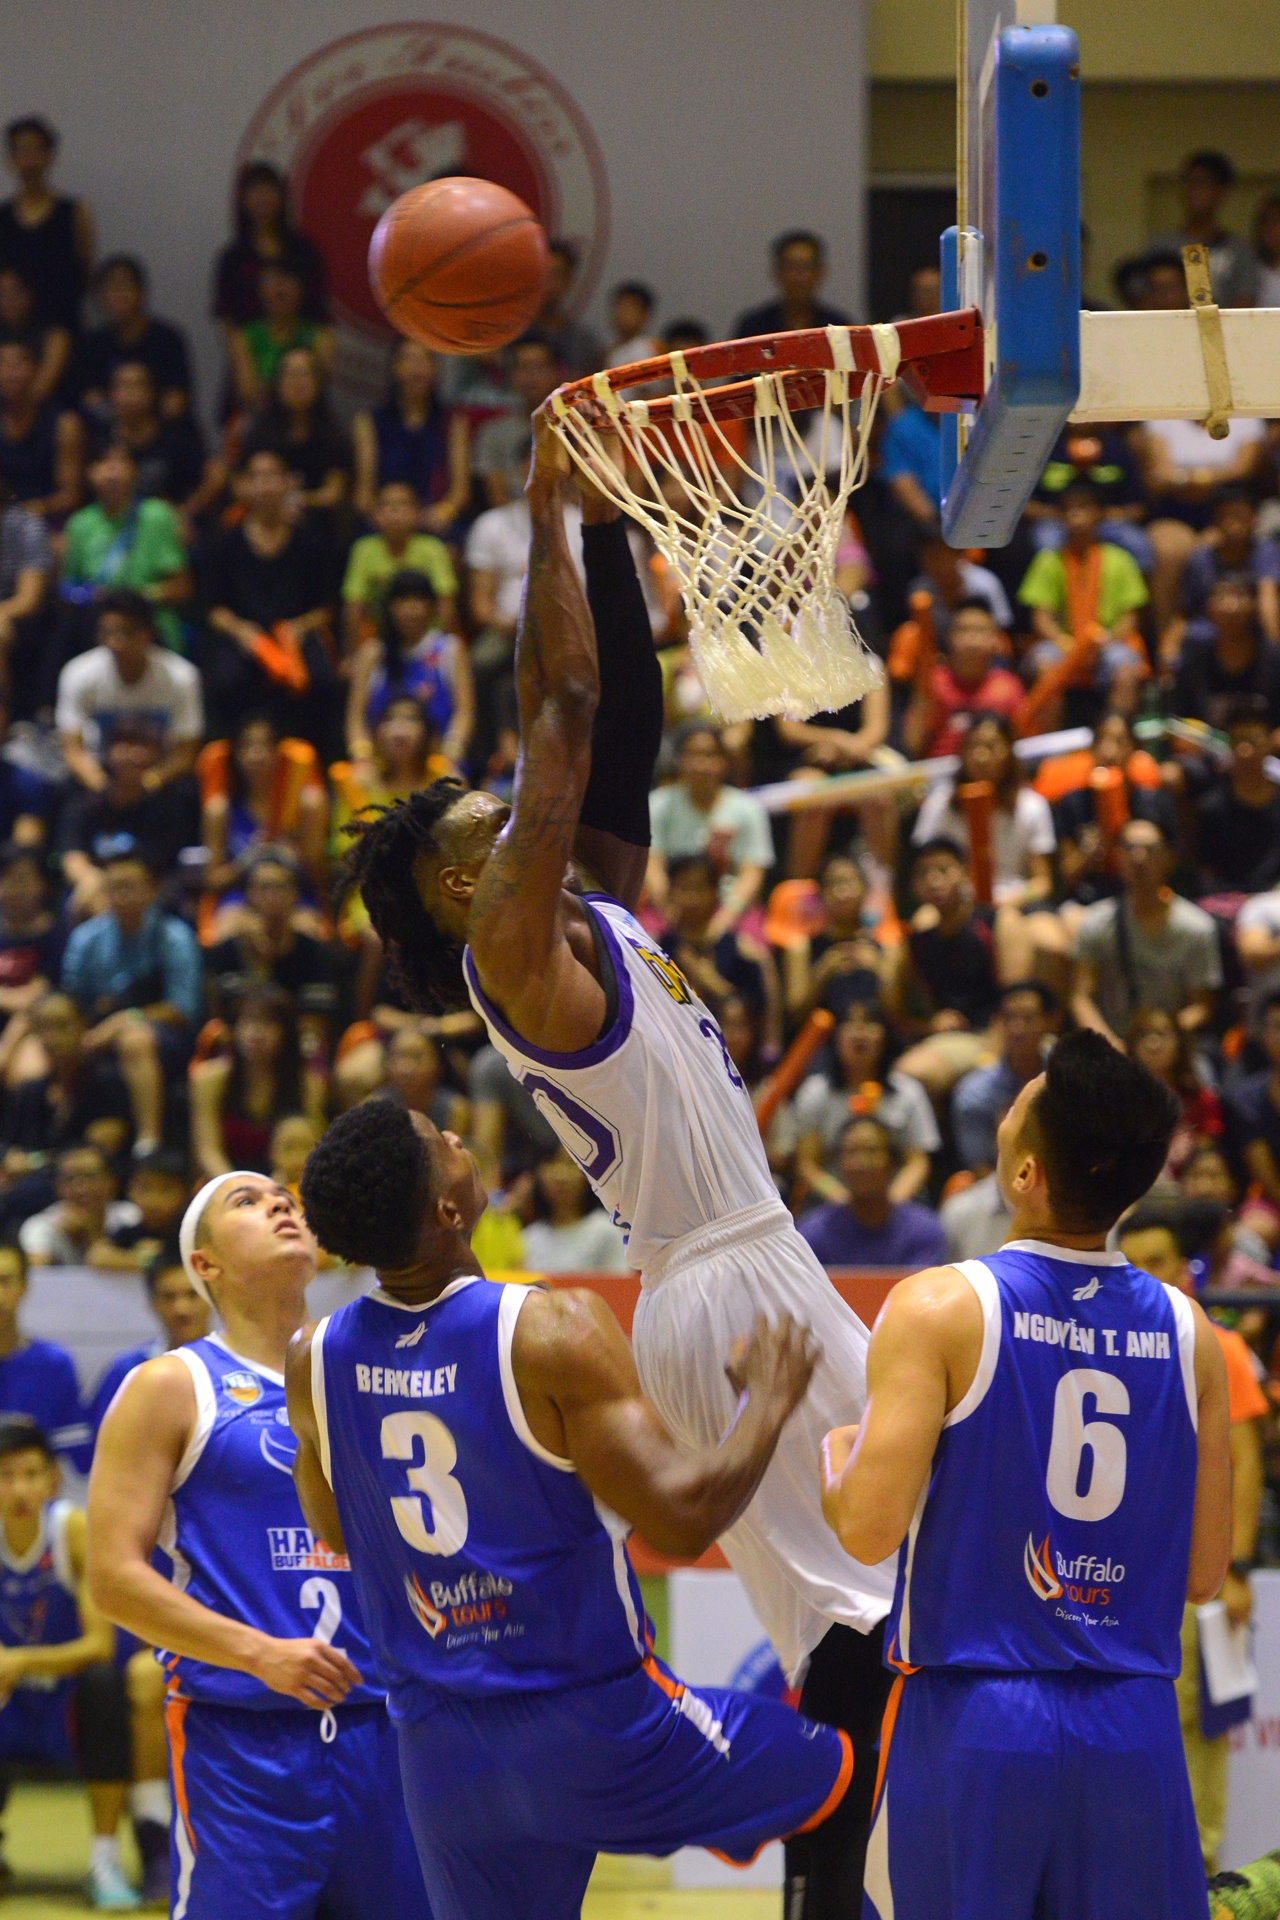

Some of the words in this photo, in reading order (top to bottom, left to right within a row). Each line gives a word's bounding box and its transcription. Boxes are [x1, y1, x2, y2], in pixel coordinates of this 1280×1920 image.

[1102, 1329, 1120, 1357] T.
[1126, 1330, 1171, 1360] ANH
[355, 1363, 457, 1398] BERKELEY
[1045, 1368, 1131, 1522] 6
[380, 1410, 469, 1558] 3
[1056, 1550, 1125, 1583] Buffalo
[430, 1570, 513, 1609] Buffalo
[300, 1576, 349, 1660] 2
[451, 1597, 507, 1628] tours
